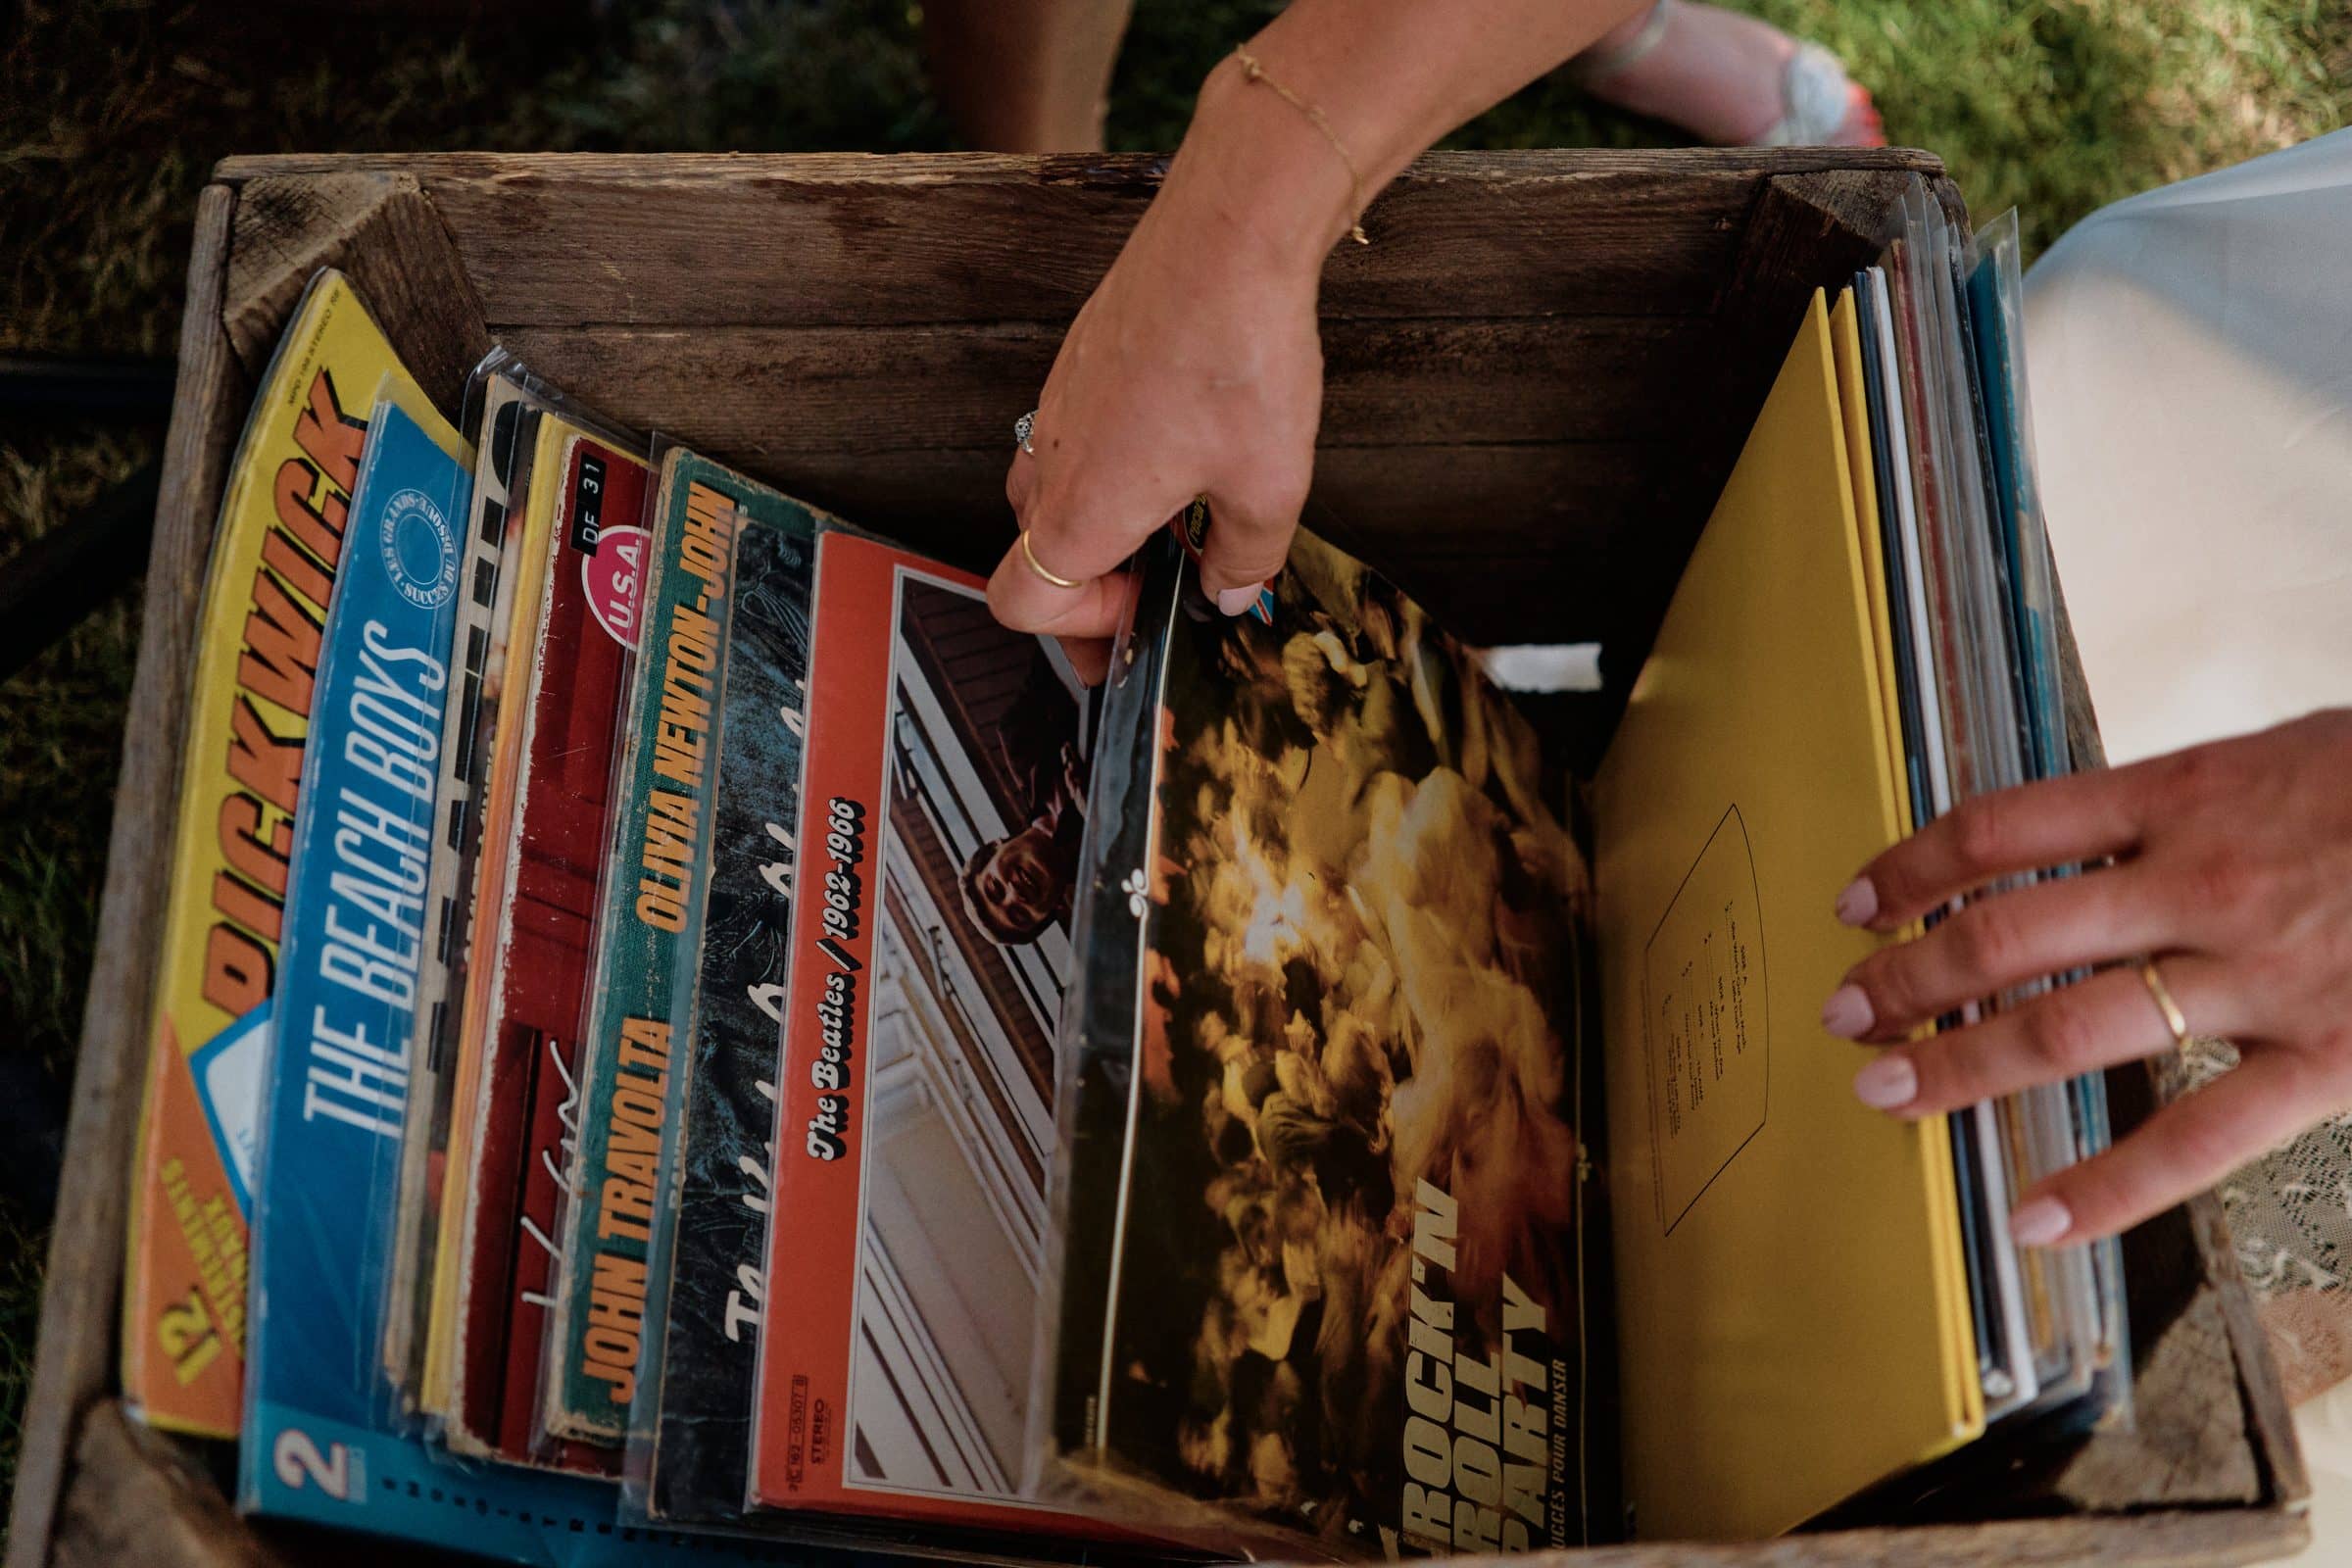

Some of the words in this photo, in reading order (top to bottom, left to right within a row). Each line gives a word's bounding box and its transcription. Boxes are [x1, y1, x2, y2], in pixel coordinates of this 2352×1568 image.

[383, 494, 416, 544] GRANDS
[582, 463, 600, 494] 31
[383, 547, 403, 583] LES
[444, 558, 456, 584] DU
[581, 511, 600, 545] DF
[608, 539, 640, 629] U.S.A.
[655, 480, 737, 787] NEWTON-JOHN
[343, 619, 447, 805] BOYS
[319, 788, 430, 1013] BEACH
[636, 789, 693, 934] OLIVIA
[821, 797, 865, 941] 1962-1966
[304, 1004, 410, 1137] THE
[811, 972, 855, 1092] Beatles
[598, 1015, 674, 1240] TRAVOLTA
[808, 1094, 846, 1163] The
[158, 1290, 221, 1387] 12
[583, 1255, 647, 1404] JOHN
[810, 1397, 825, 1464] STEREO
[1502, 1272, 1548, 1555] PARTY
[1552, 1358, 1567, 1429] DANSER
[274, 1429, 348, 1501] 2
[1453, 1351, 1502, 1553] ROLL
[1552, 1433, 1567, 1484] POUR
[1551, 1488, 1567, 1550] UCCÈS
